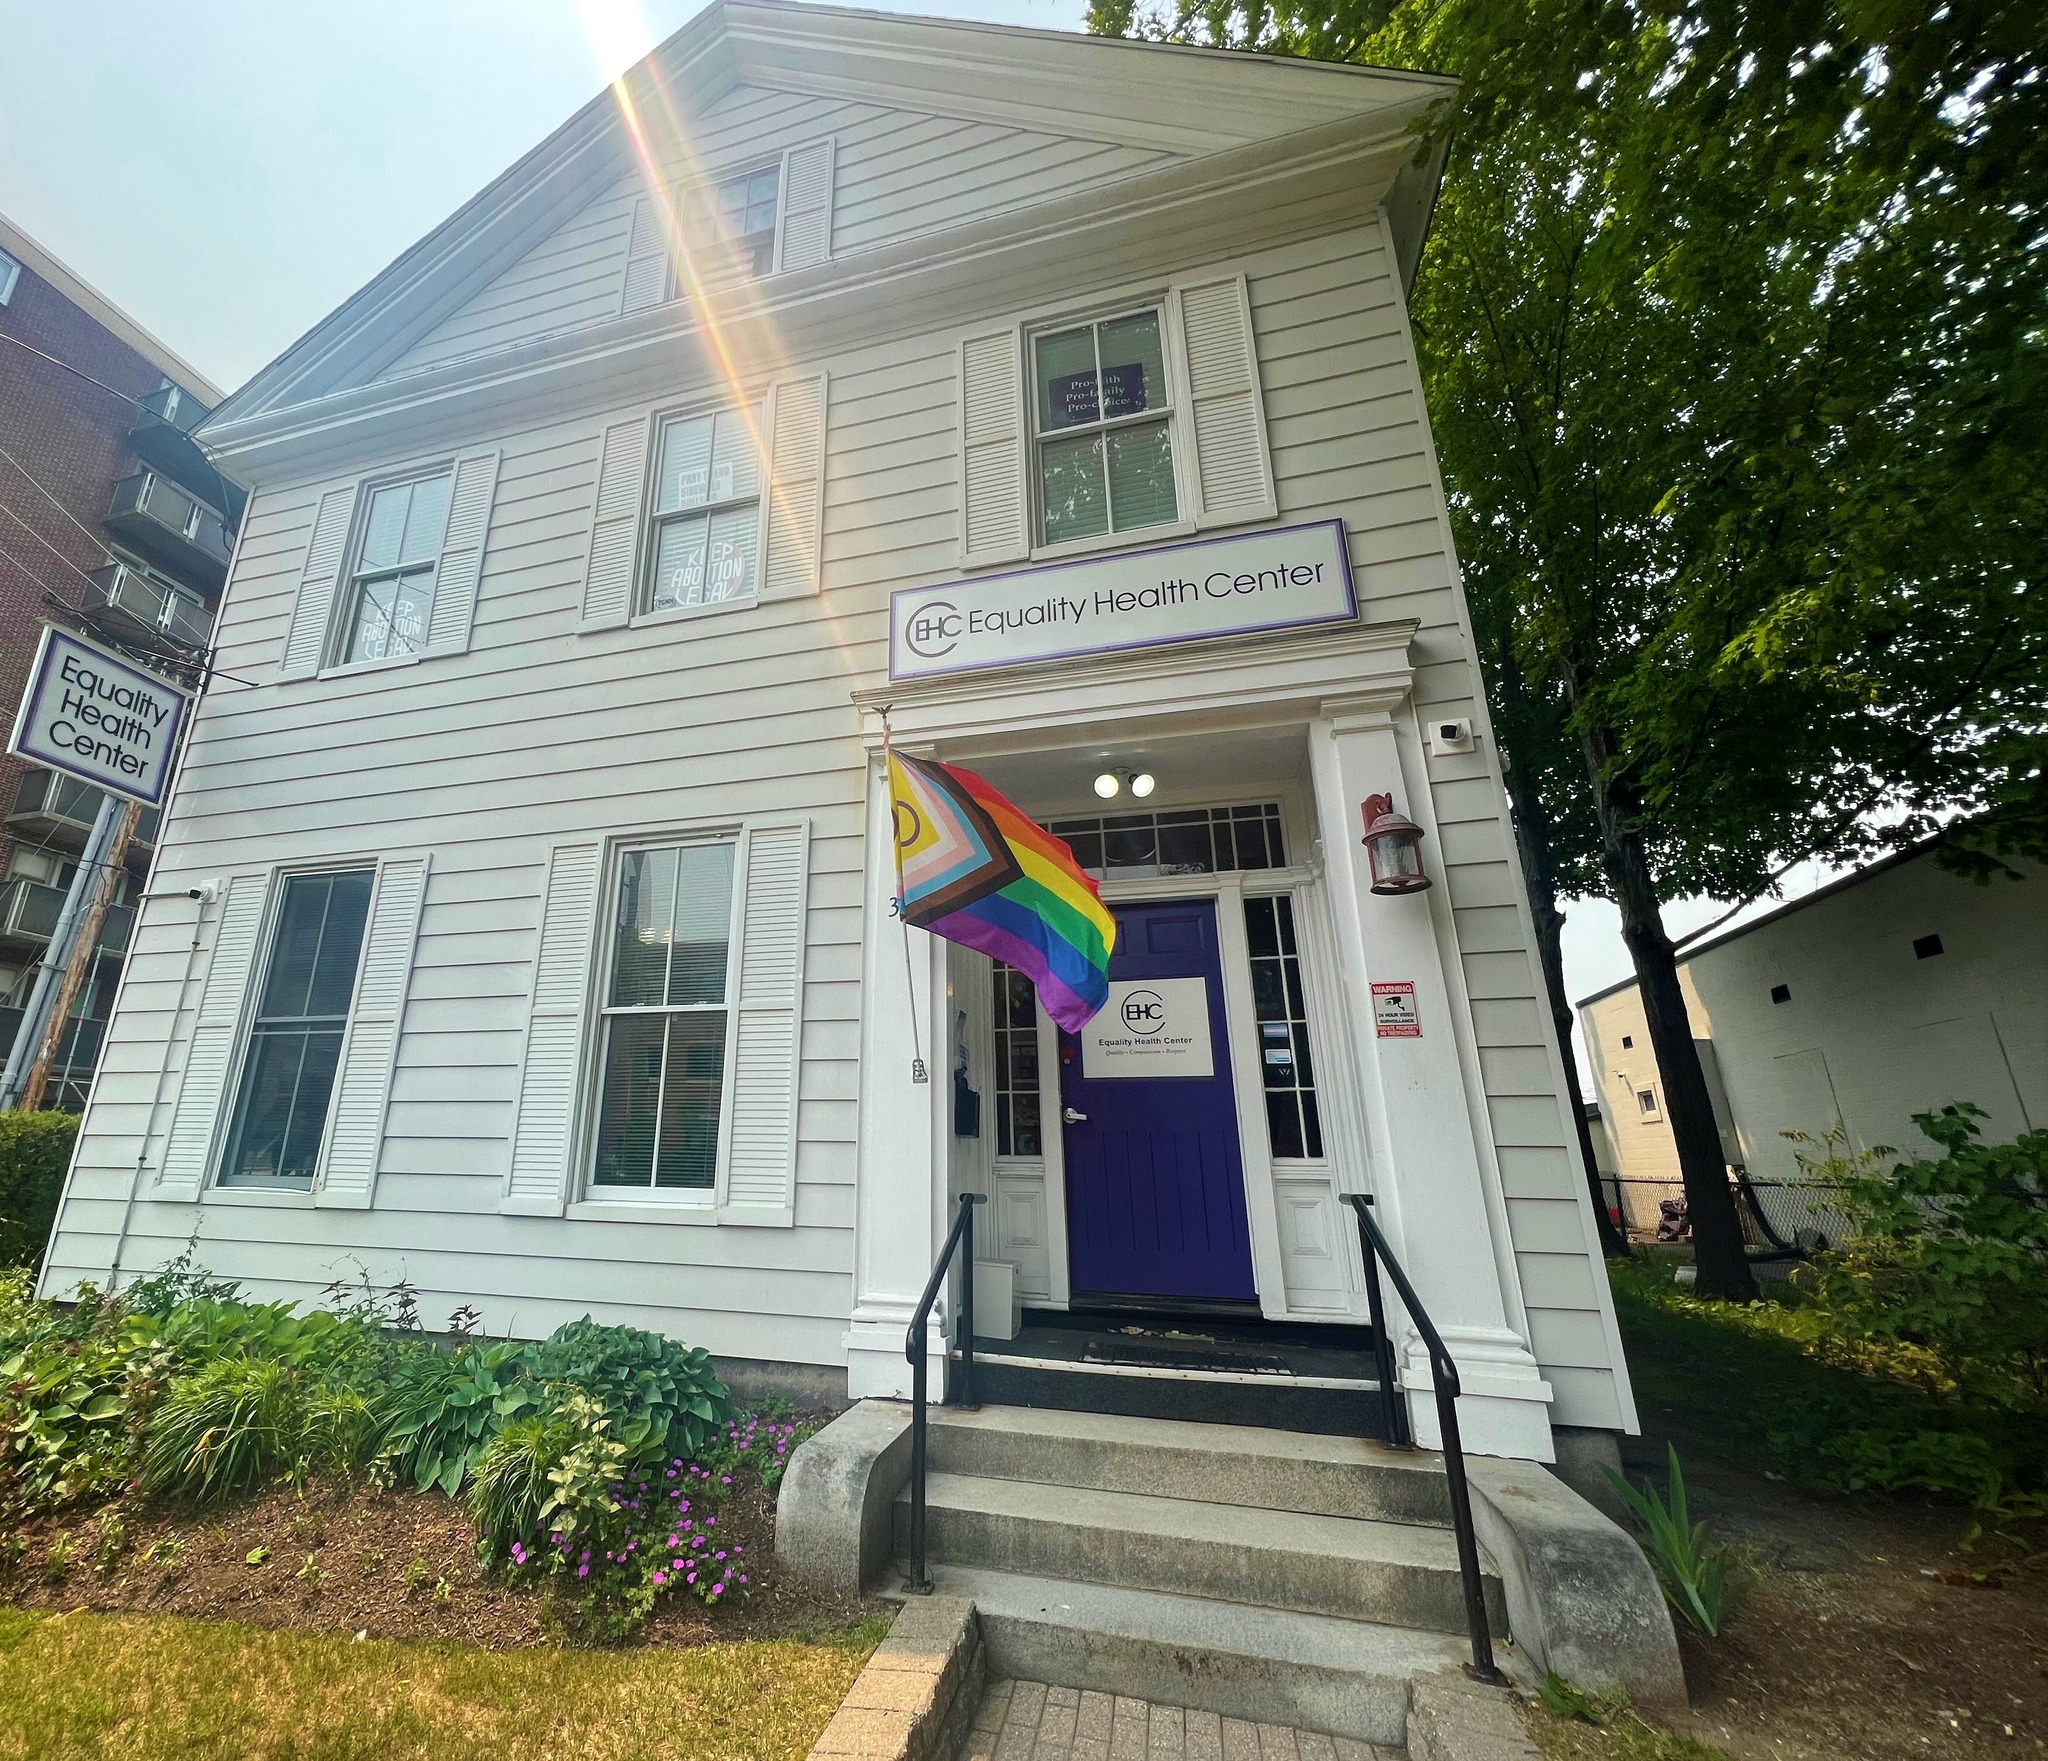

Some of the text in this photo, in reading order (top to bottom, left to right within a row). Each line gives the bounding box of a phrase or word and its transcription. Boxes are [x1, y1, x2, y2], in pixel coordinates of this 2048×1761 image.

[671, 557, 742, 588] ABOTION
[969, 597, 1088, 635] Equality
[1094, 577, 1199, 615] Health
[1204, 560, 1324, 598] Center
[60, 655, 169, 728] Equality
[60, 688, 152, 749] Health
[49, 720, 149, 779] Center
[1372, 985, 1412, 993] WARNING
[1098, 1037, 1192, 1047] Equality Health Center
